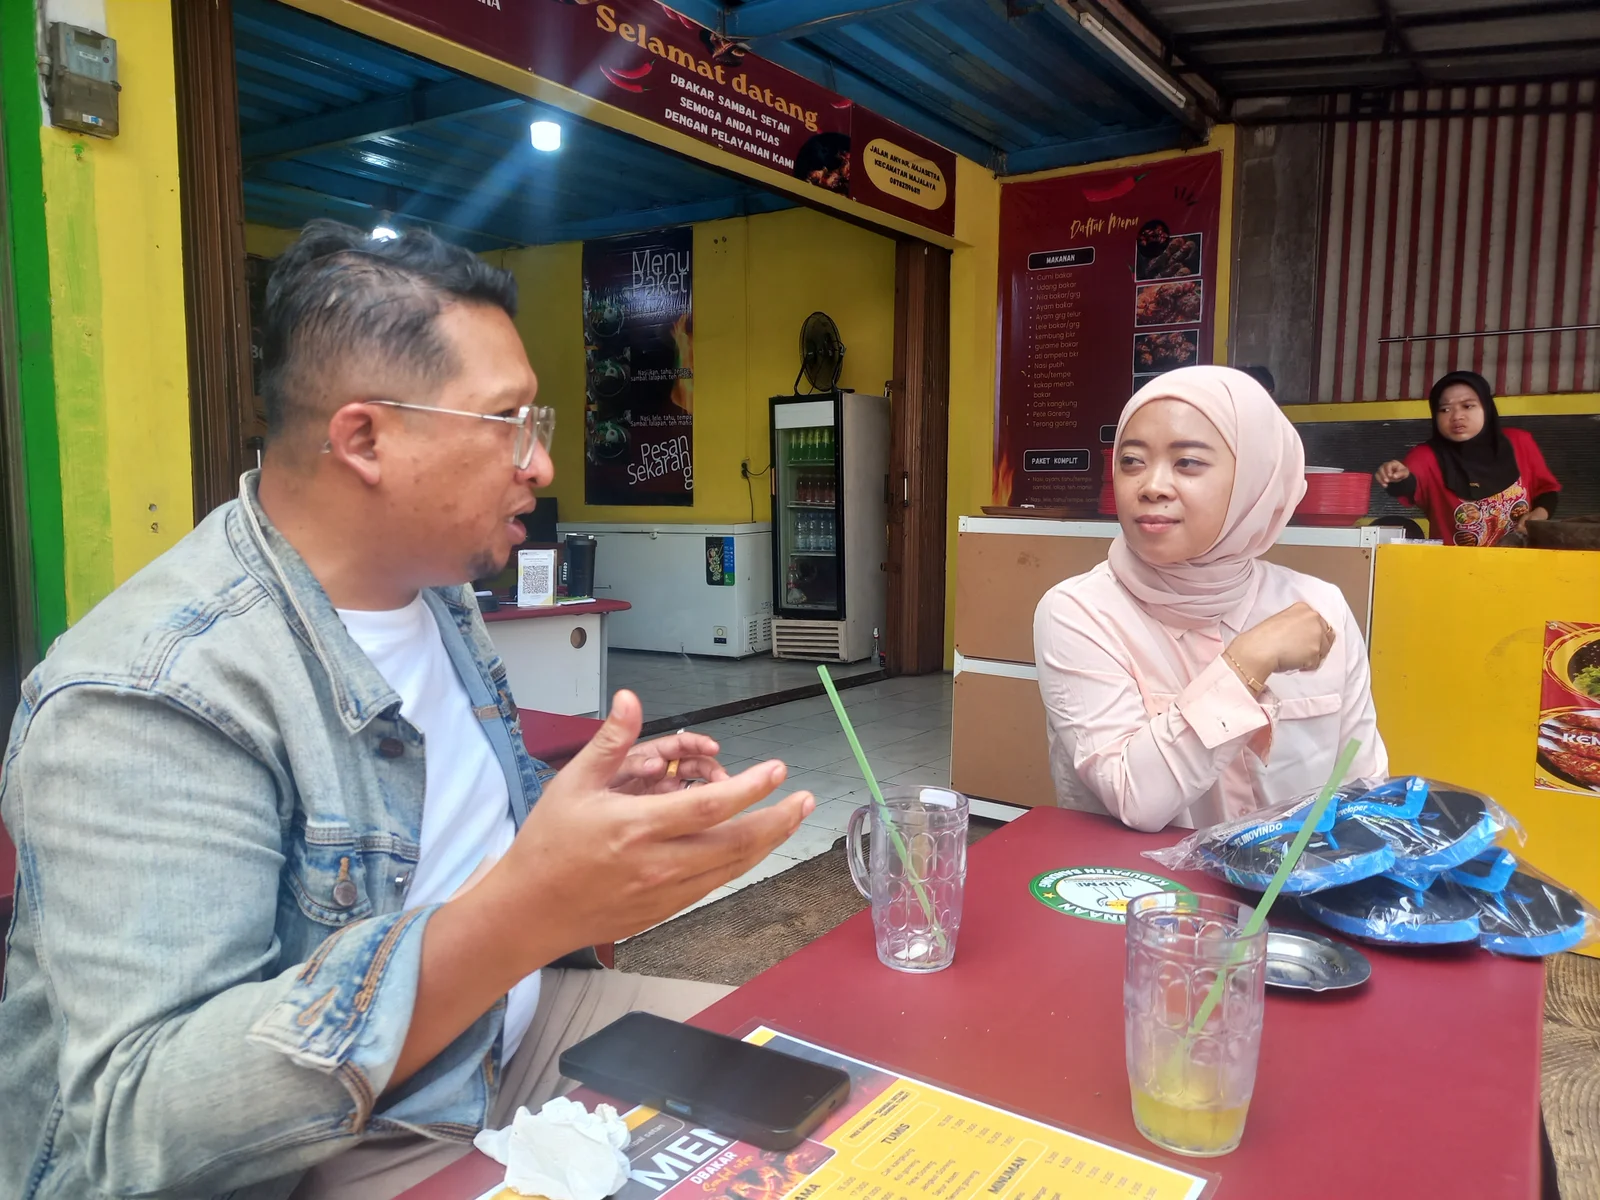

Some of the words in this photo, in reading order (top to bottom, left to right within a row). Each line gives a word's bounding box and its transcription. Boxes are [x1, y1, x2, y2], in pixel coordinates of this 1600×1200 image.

[596, 4, 726, 85] Selamat
[731, 73, 818, 132] datang
[670, 73, 715, 101] DBAKAR
[718, 95, 758, 121] SAMBAL
[761, 114, 791, 135] SETAN
[680, 96, 722, 122] SEMOGA
[725, 116, 752, 136] ANDA
[755, 129, 780, 147] PUAS
[665, 108, 708, 135] DENGAN
[711, 128, 770, 160] PELAYANAN
[773, 152, 795, 170] KAMI
[870, 145, 888, 159] JALAN
[875, 158, 908, 178] KECAMATAN
[908, 173, 936, 191] MAJALAYA
[1070, 217, 1104, 239] Daftar
[1107, 212, 1139, 235] Menu
[632, 249, 689, 277] Menu
[1046, 254, 1075, 264] MAKANAN
[632, 267, 687, 298] Paket
[1036, 273, 1053, 281] Cumi
[1036, 283, 1057, 291] Udang
[1036, 304, 1054, 312] Ayam
[1035, 332, 1064, 340] kembung
[1043, 352, 1068, 360] ampela
[1048, 361, 1065, 370] putih
[1034, 370, 1071, 379] tahu/tempe
[1033, 382, 1052, 390] kakap
[1053, 380, 1074, 388] merah
[1033, 391, 1051, 399] bakar
[1047, 400, 1078, 409] kangkung
[1047, 410, 1070, 419] Goreng
[1033, 421, 1054, 429] Terong
[1055, 420, 1077, 428] goreng
[641, 435, 688, 464] Pesan
[1031, 457, 1051, 465] PAKET
[1054, 457, 1078, 465] KOMPLIT
[627, 450, 693, 490] Sekarang
[1241, 822, 1283, 844] INOVINDO
[1083, 867, 1170, 887] KABUPATEN
[881, 1123, 910, 1144] TUMIS
[690, 1151, 738, 1185] DBAKAR
[988, 1156, 1027, 1195] MINUMAN
